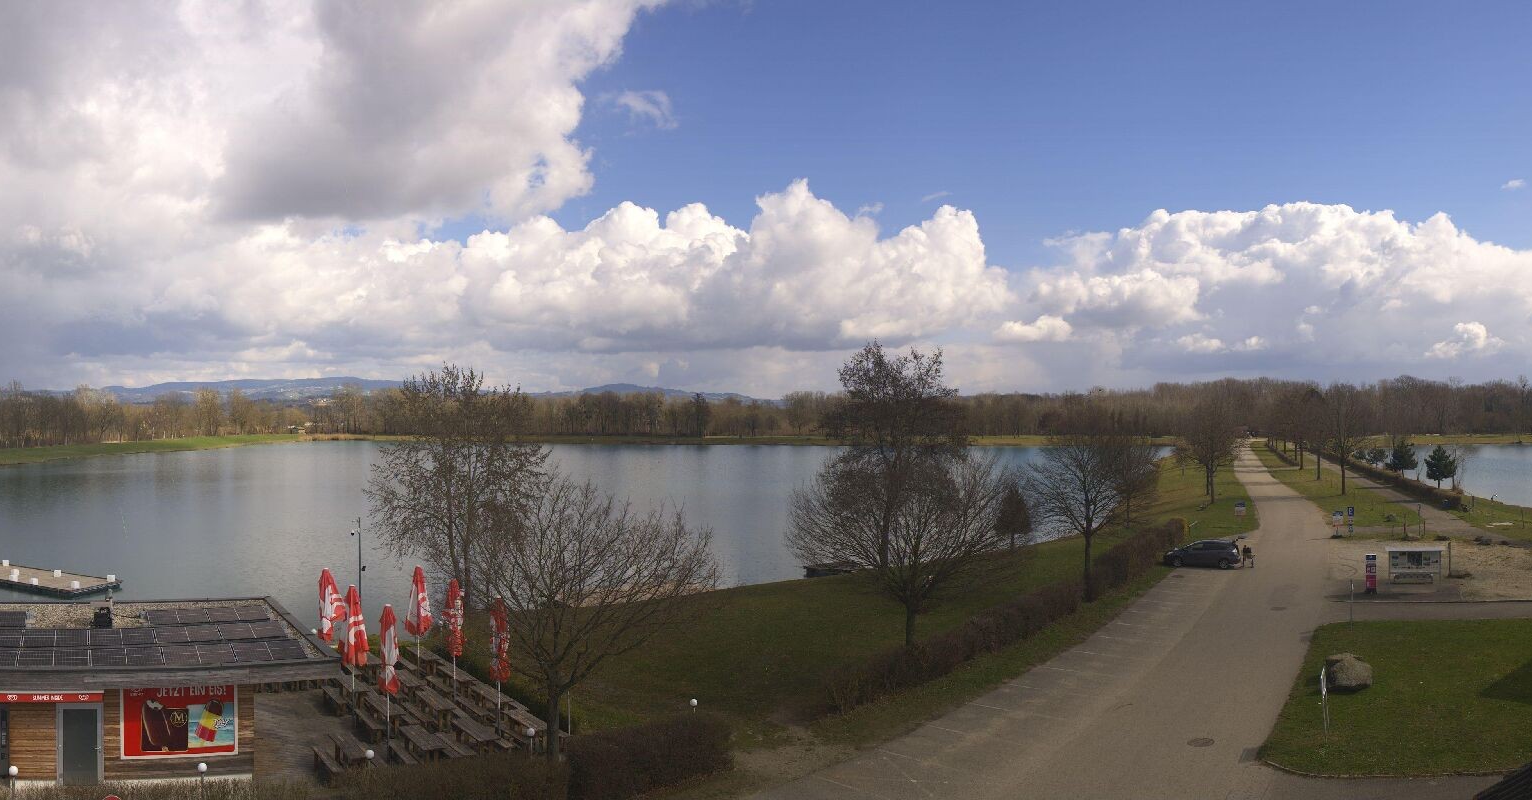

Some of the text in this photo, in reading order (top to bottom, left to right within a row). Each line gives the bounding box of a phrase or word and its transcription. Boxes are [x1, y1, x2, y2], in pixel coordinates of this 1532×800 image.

[157, 685, 226, 697] JETZT EIN EIS!
